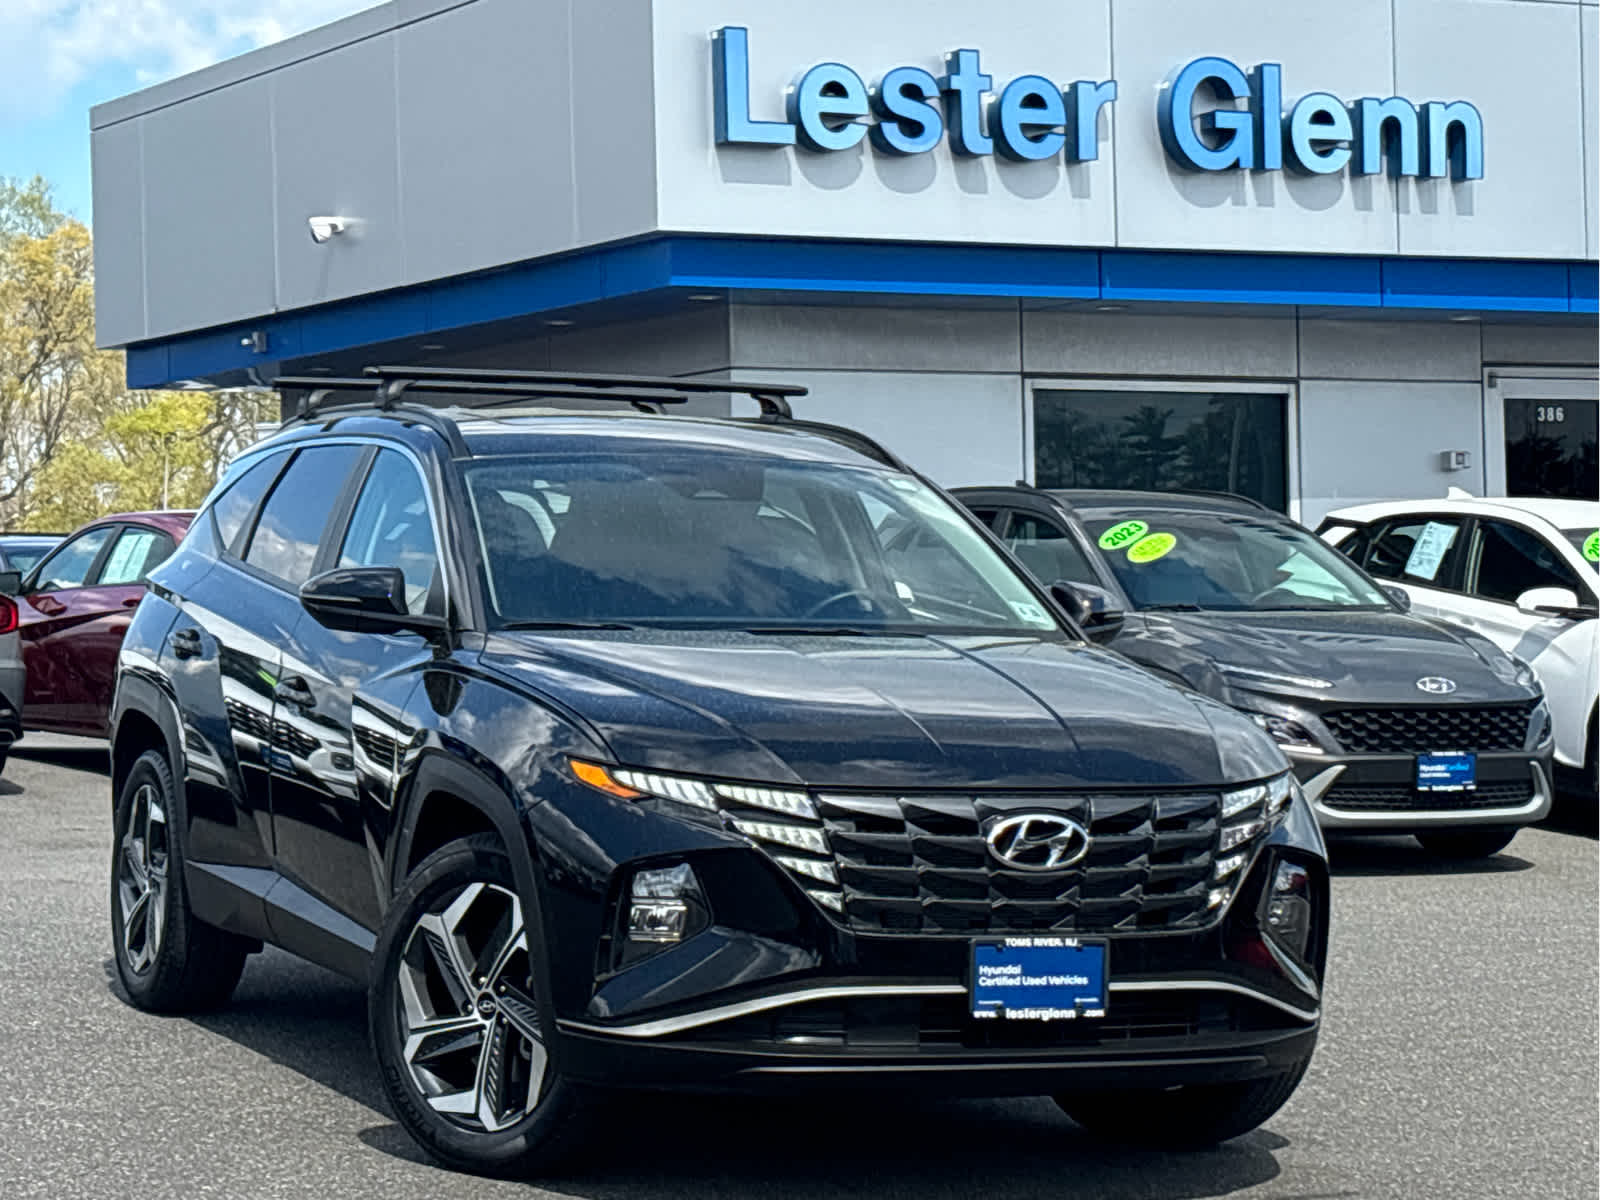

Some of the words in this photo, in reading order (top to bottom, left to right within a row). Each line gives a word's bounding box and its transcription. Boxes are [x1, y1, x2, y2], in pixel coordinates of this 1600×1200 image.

[711, 26, 1118, 163] Lester
[1157, 56, 1485, 181] Glenn
[1537, 406, 1564, 421] 386
[1105, 523, 1143, 546] 2023
[1004, 937, 1032, 947] TOMS
[979, 964, 1022, 976] Hyundai
[978, 976, 1020, 986] Certified
[1022, 976, 1047, 985] Used
[1047, 975, 1089, 985] Vehicles
[1005, 1007, 1076, 1021] lesterglenn
